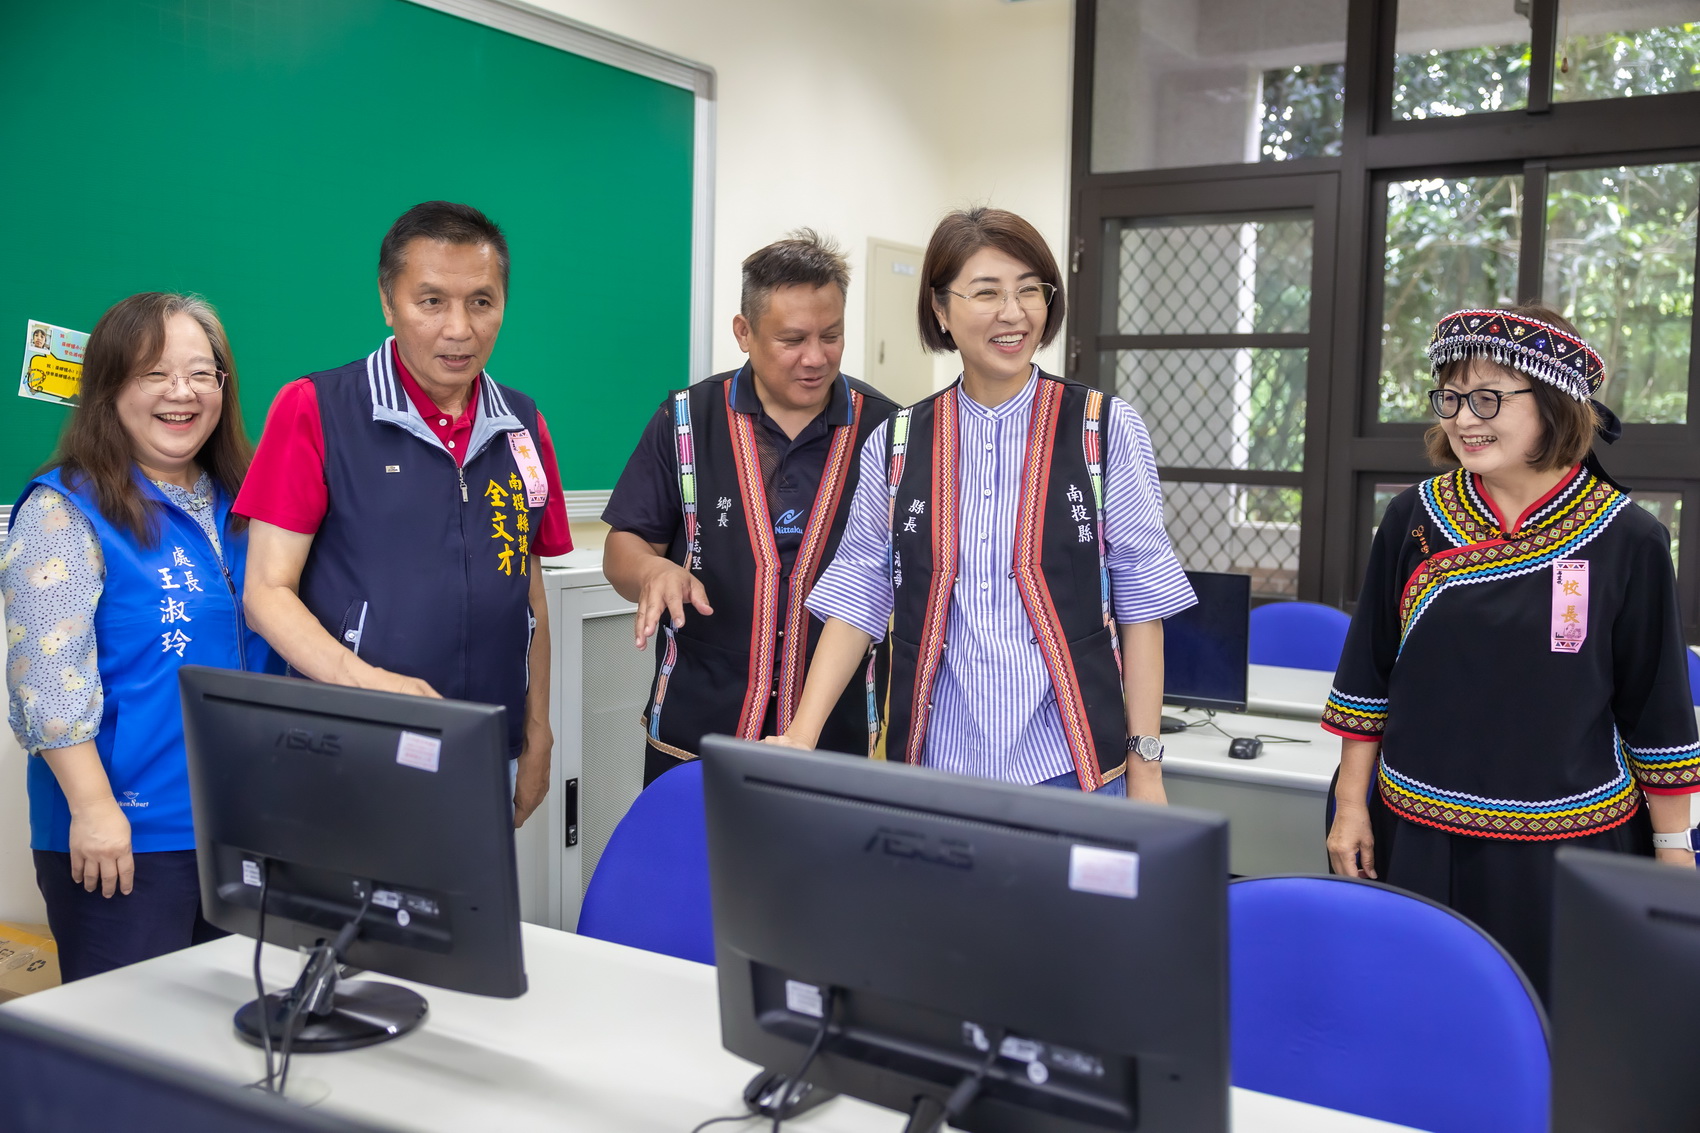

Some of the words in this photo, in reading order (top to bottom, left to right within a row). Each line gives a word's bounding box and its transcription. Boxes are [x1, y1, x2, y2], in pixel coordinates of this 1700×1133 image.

[484, 479, 514, 576] 全文才
[508, 472, 530, 577] 南投縣議員
[716, 496, 732, 528] 鄉長
[774, 525, 803, 535] Nittaku
[903, 499, 926, 533] 縣長
[1066, 484, 1093, 543] 南投縣
[172, 546, 204, 593] 處長
[157, 567, 192, 657] 王淑玲
[1561, 580, 1582, 624] 校長
